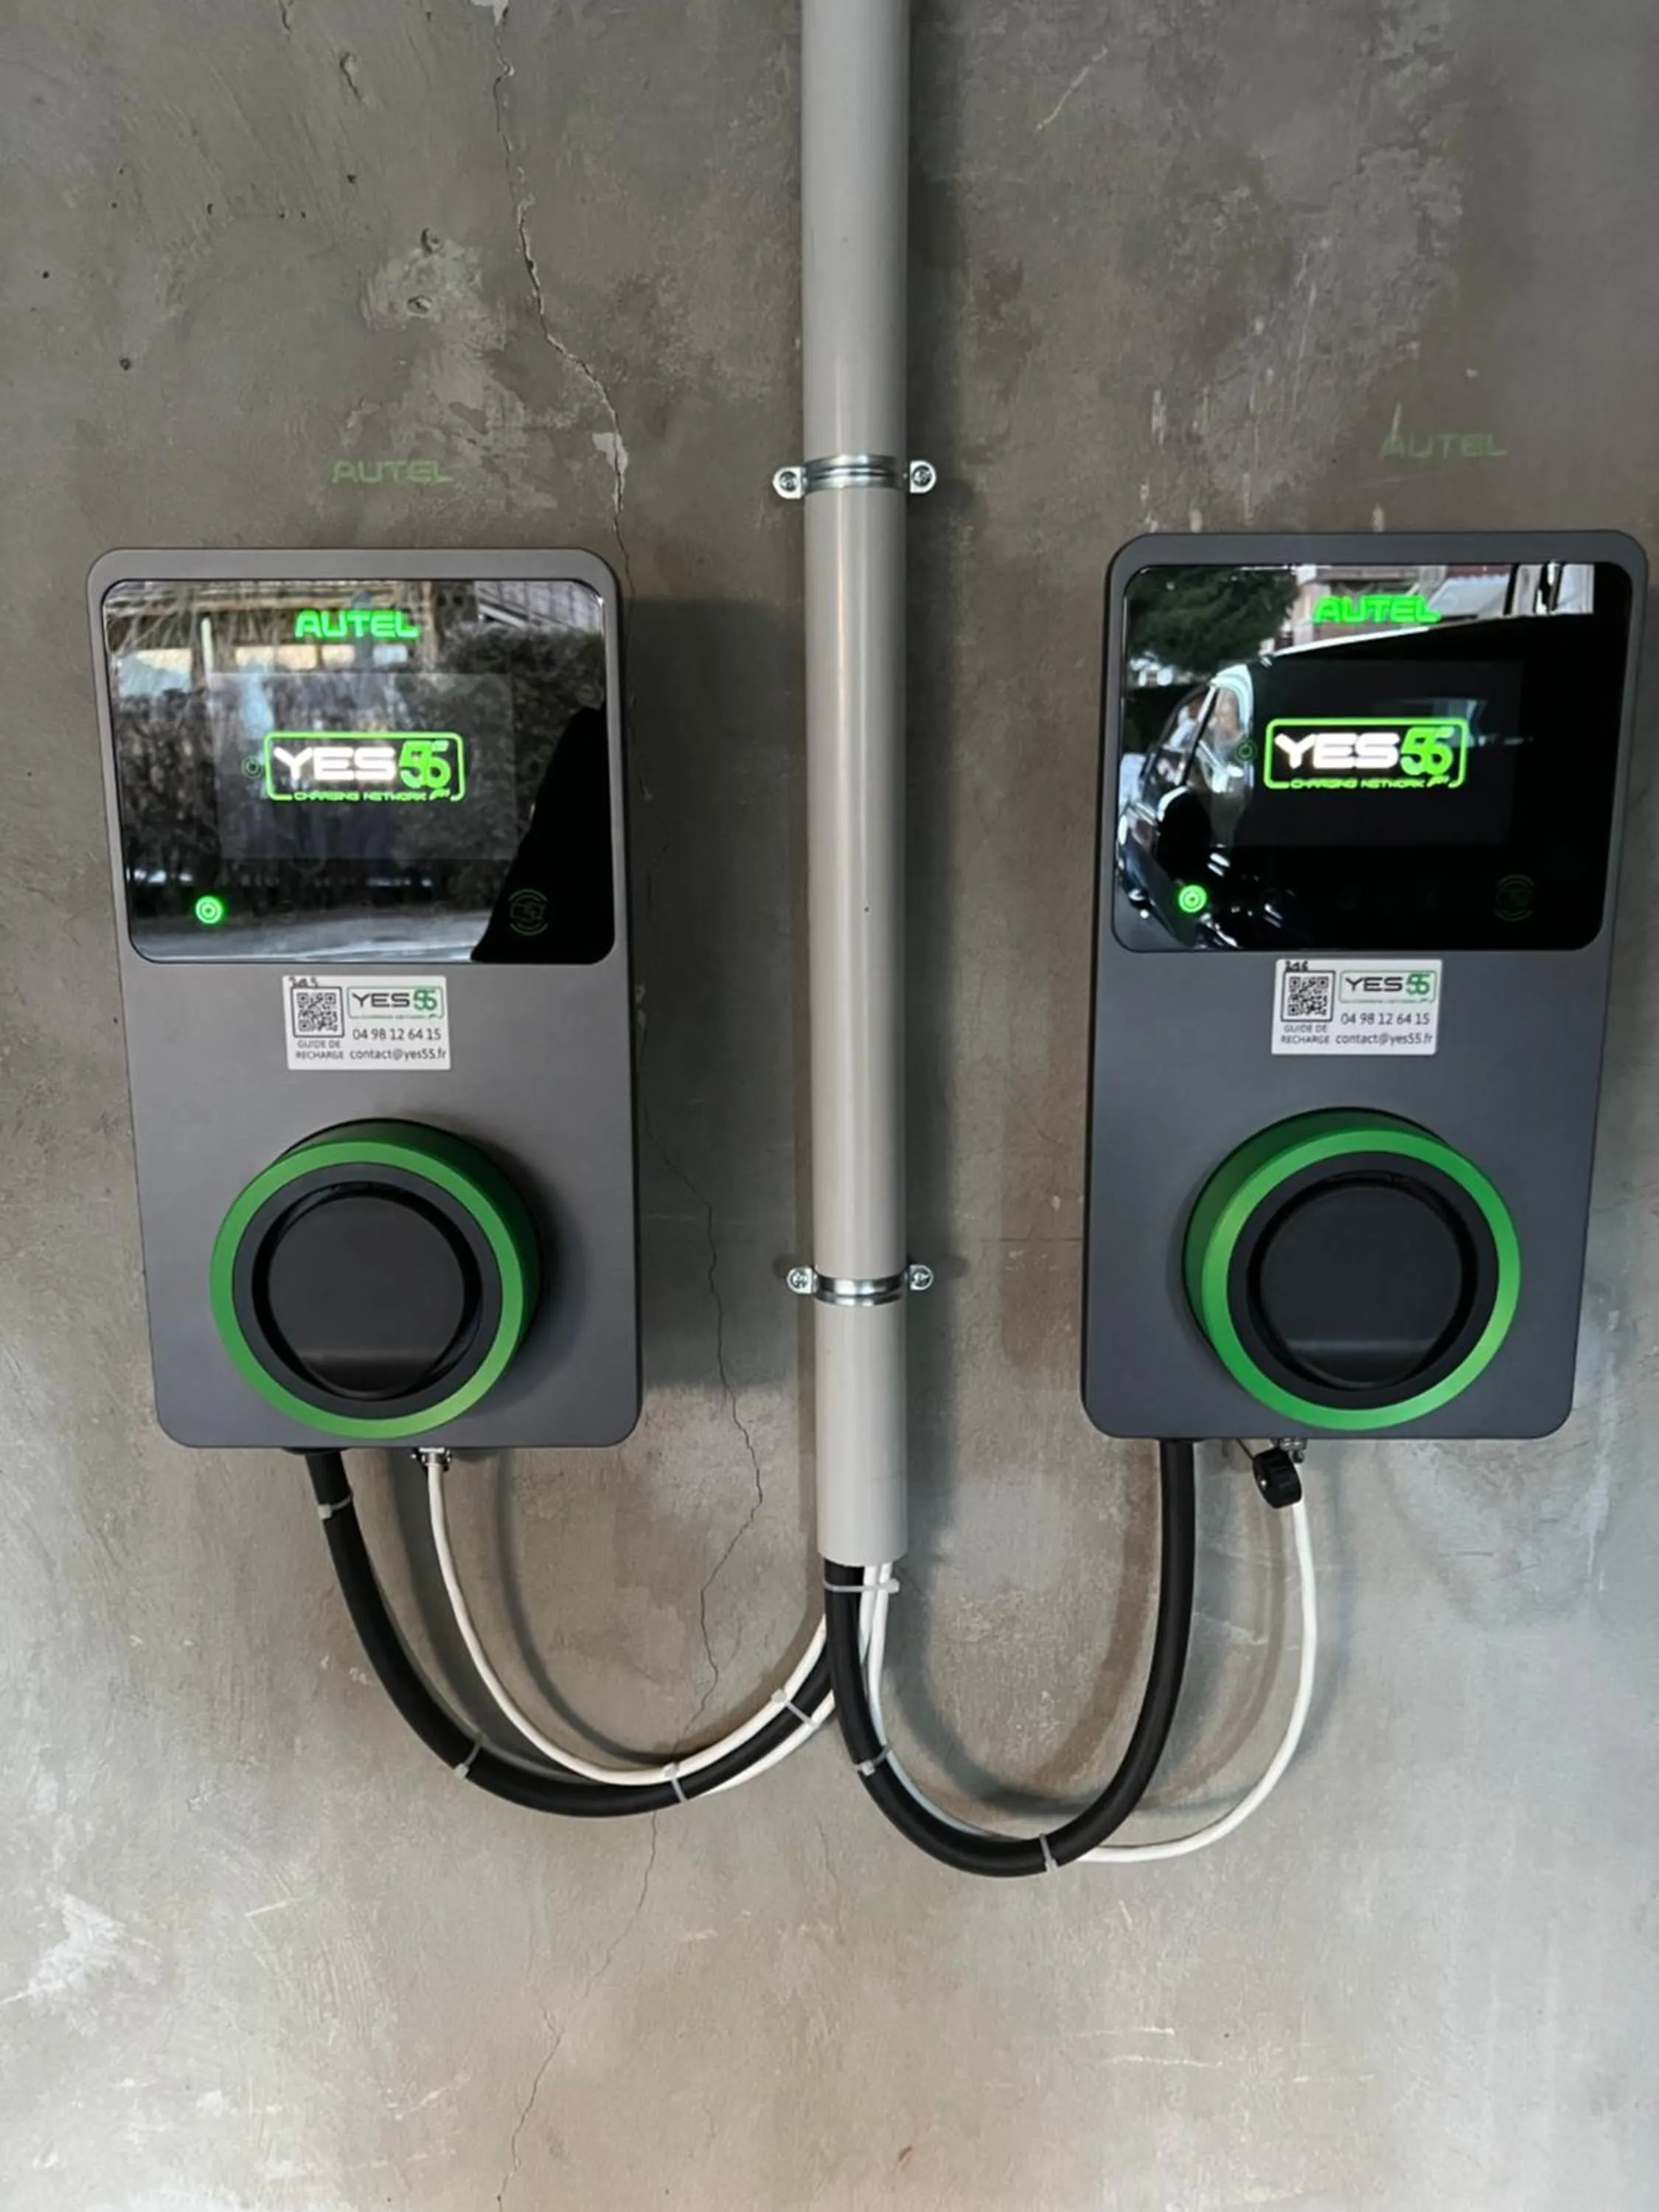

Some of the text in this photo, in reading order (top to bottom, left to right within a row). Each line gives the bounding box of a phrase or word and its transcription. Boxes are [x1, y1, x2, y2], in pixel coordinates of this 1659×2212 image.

[331, 460, 454, 484] AUTEL
[1312, 594, 1441, 624] AUTEL
[295, 609, 419, 639] AUTEL
[1340, 1013, 1430, 1026] 04 98 12 64 15
[352, 1029, 441, 1040] 04 98 12 64 15
[1284, 1024, 1326, 1033] GUIDE DE
[296, 1040, 341, 1048] GUIDE DE
[1281, 1034, 1329, 1044] RECHARGE
[1335, 1033, 1433, 1046] contact@yes55.fr
[296, 1051, 344, 1060] RECHARGE
[349, 1048, 446, 1061] contact@yes55.fr
